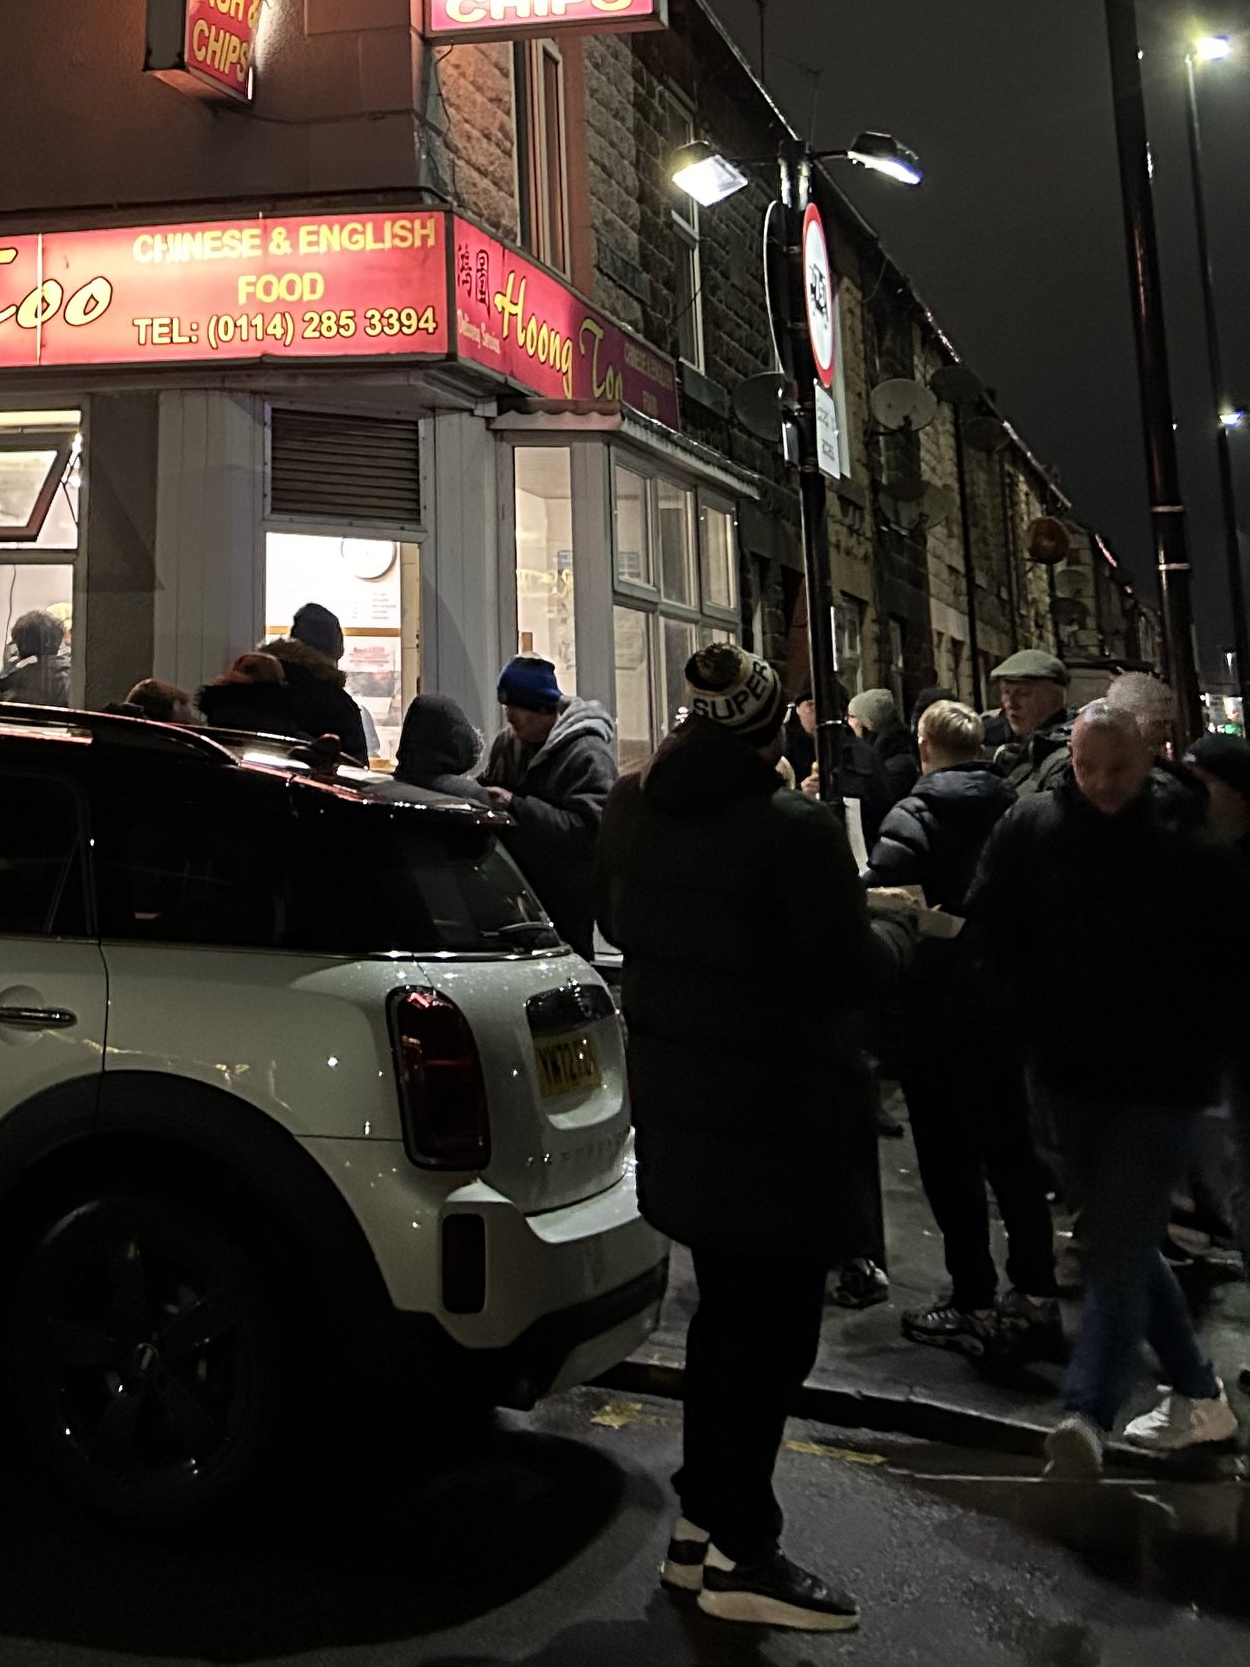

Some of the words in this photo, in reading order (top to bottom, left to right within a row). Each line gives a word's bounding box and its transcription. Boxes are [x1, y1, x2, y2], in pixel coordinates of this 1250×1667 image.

[193, 19, 249, 83] CHIPS
[133, 227, 263, 264] CHINESE
[269, 226, 292, 256] &
[299, 217, 436, 255] ENGLISH
[238, 272, 325, 306] FOOD
[133, 316, 198, 346] TEL:
[207, 312, 295, 350] (0114)
[302, 309, 356, 339] 285
[364, 306, 437, 338] 3394
[493, 270, 573, 399] Hoong
[693, 661, 769, 720] SUPER
